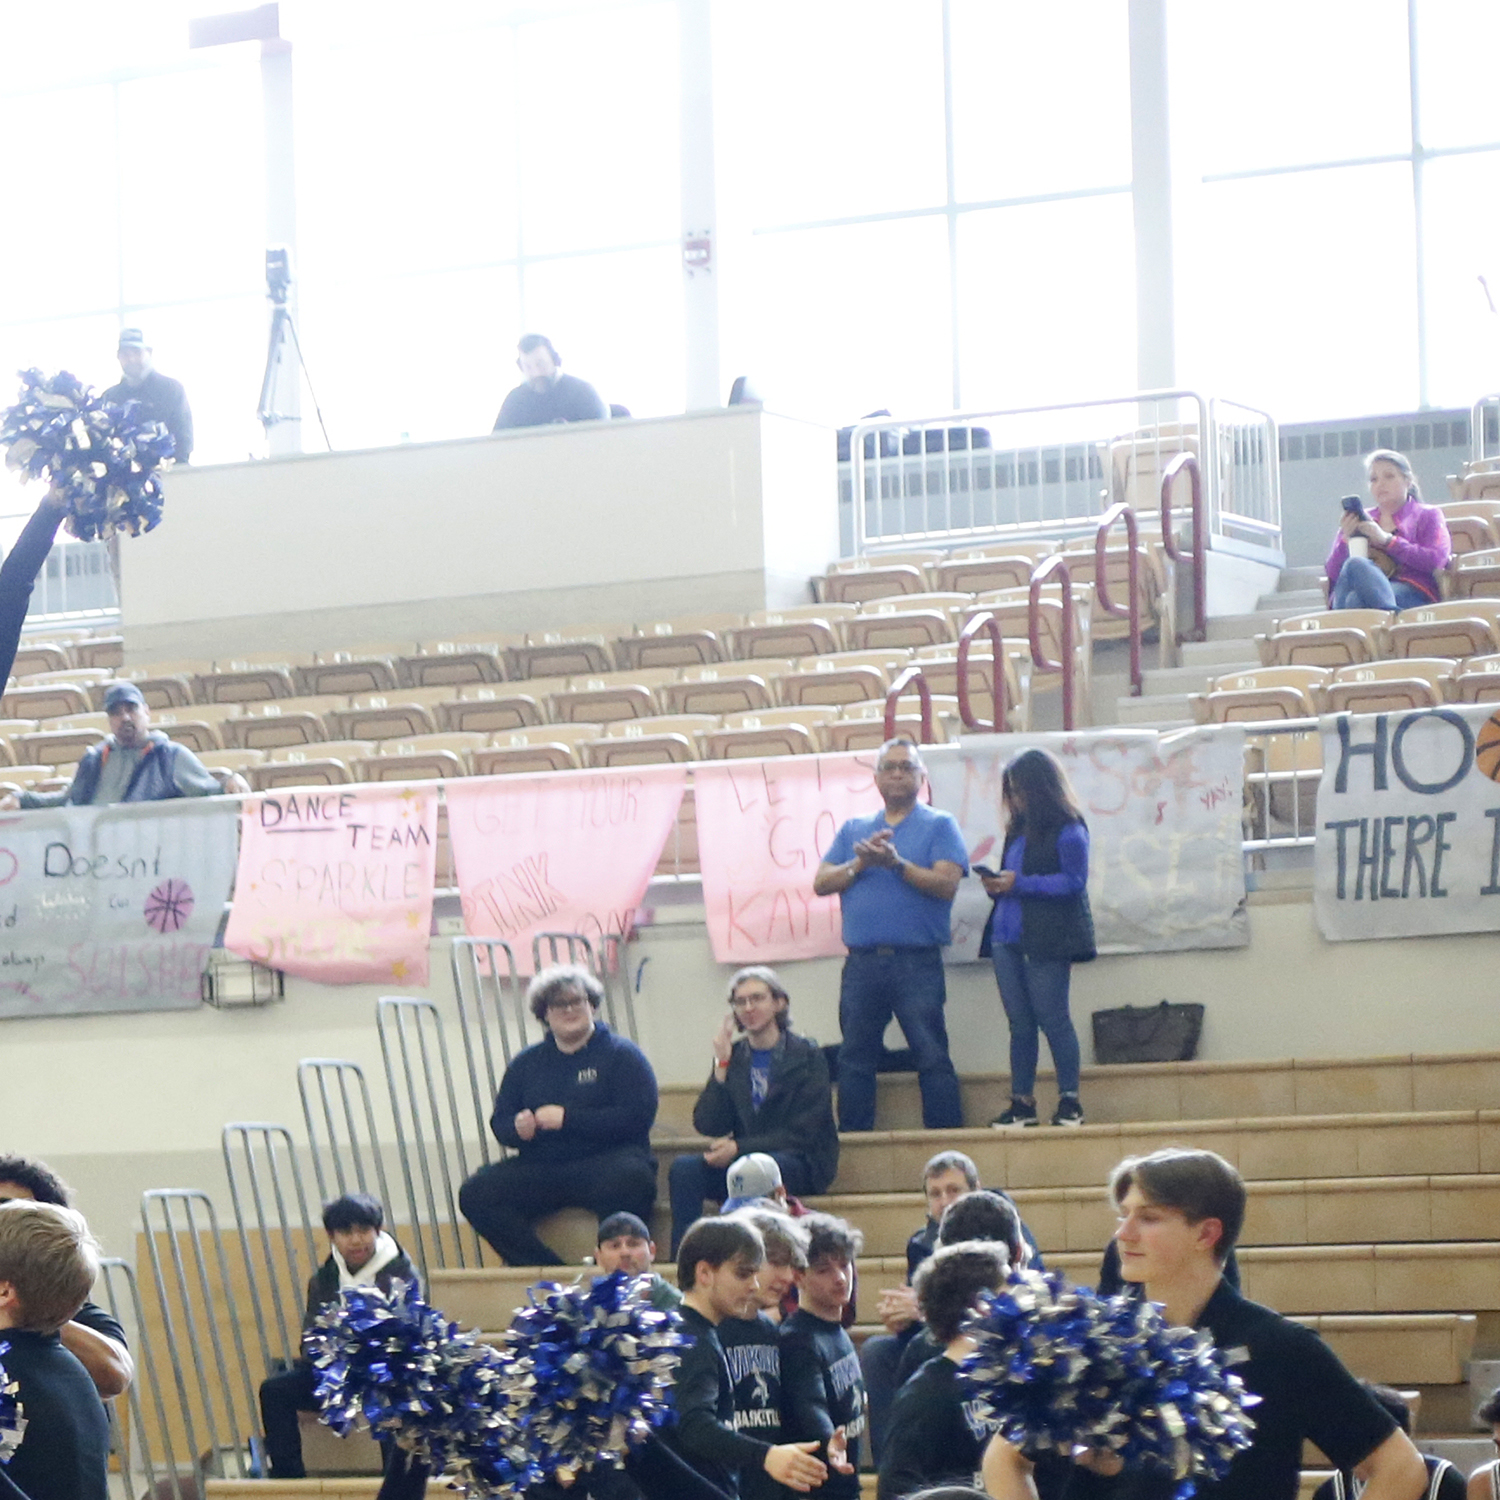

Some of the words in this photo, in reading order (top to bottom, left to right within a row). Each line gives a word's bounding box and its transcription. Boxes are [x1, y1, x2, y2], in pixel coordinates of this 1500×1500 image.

[261, 792, 357, 827] DANCE
[472, 778, 551, 836] GET
[580, 776, 643, 829] YOUR
[346, 822, 431, 850] TEAM
[1325, 810, 1457, 901] THERE
[257, 857, 422, 909] SPARKLE
